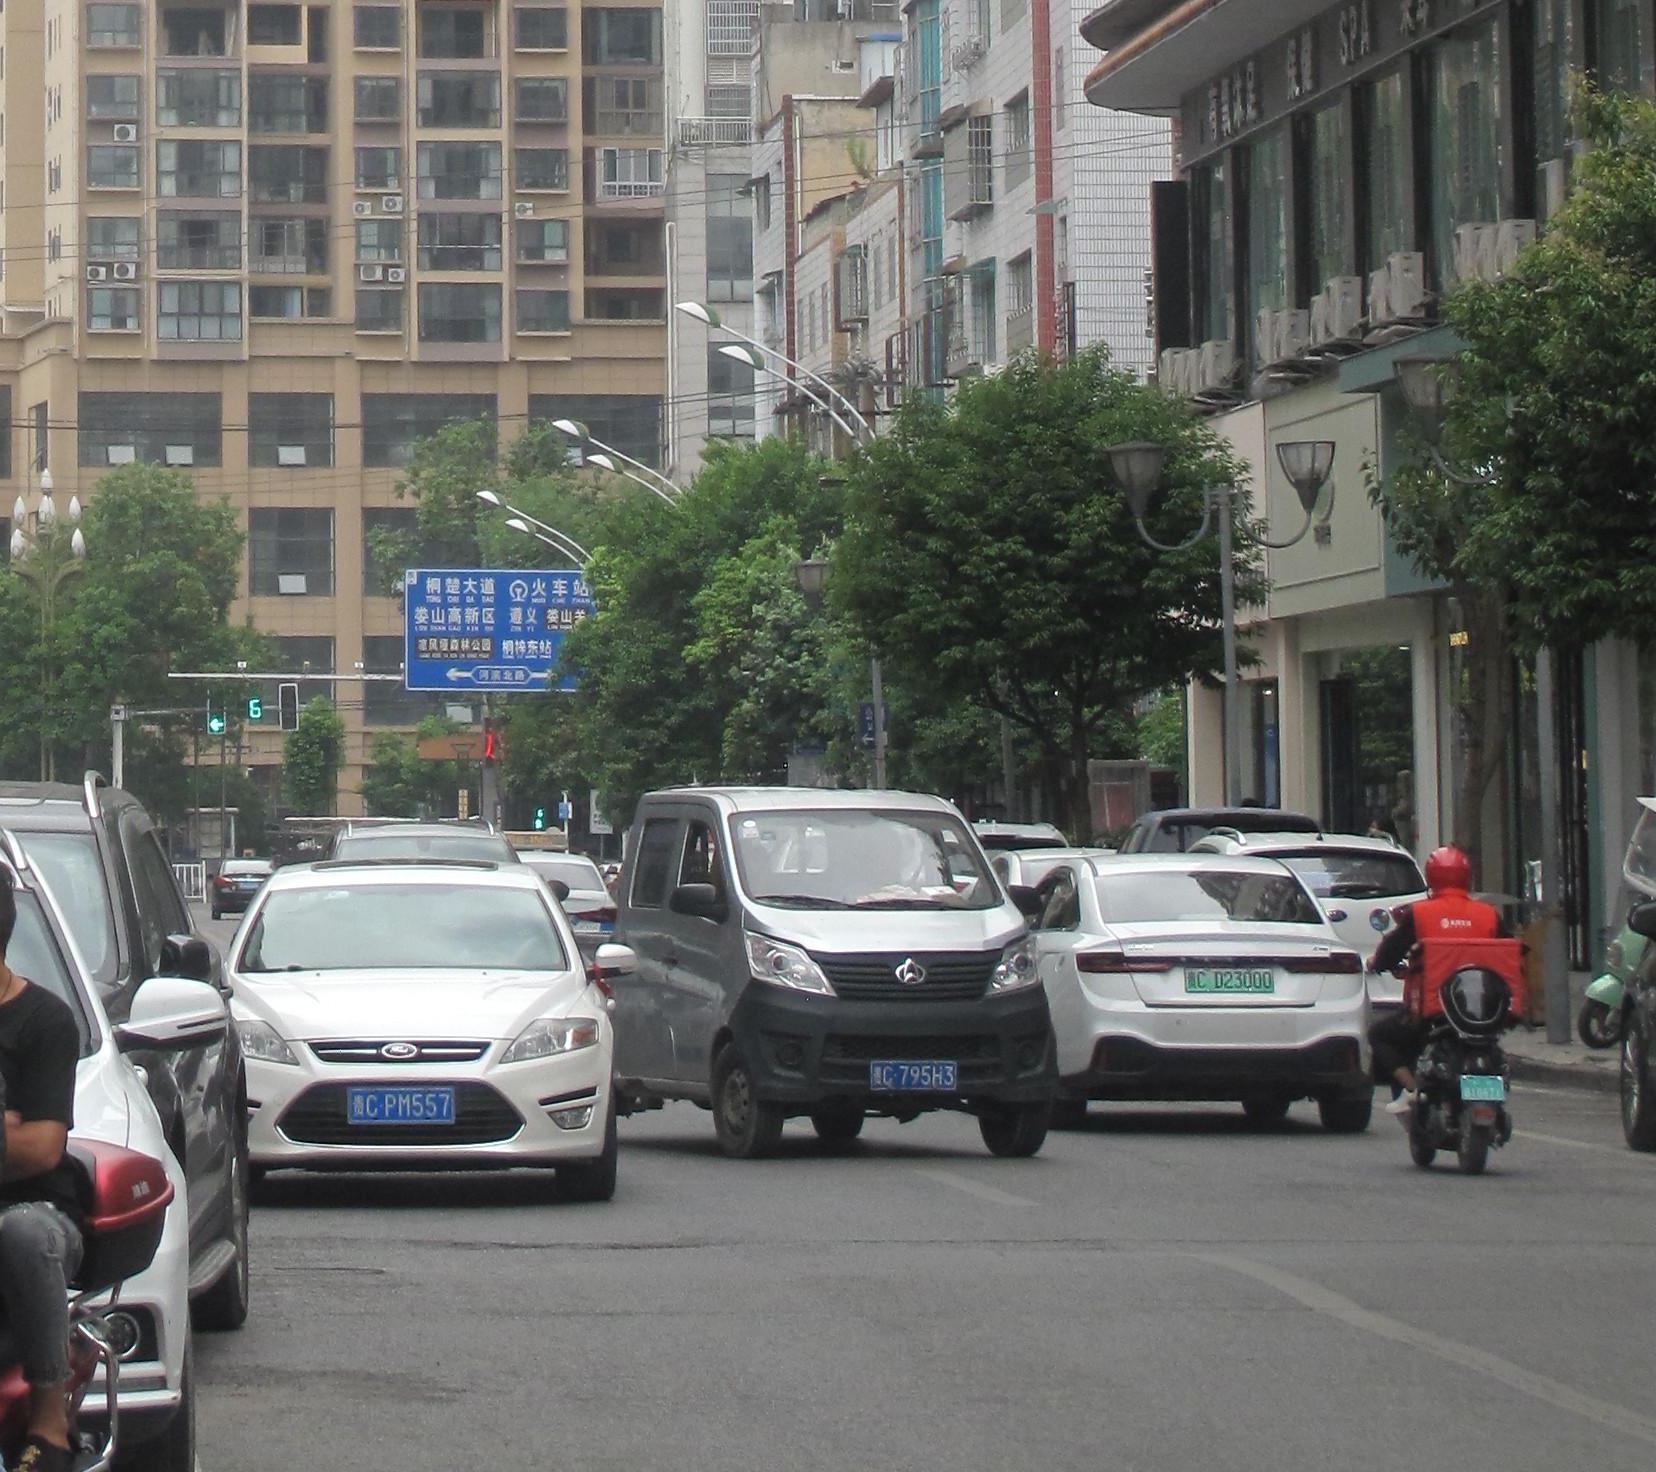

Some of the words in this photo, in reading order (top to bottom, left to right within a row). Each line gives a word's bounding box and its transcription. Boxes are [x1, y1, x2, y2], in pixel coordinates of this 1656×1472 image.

[425, 576, 495, 596] 桐楚大道
[531, 578, 590, 597] 火车站
[414, 607, 495, 625] 娄山高新区
[510, 607, 538, 625] 遵义
[502, 639, 553, 656] 桐梓东站
[249, 698, 262, 719] 6
